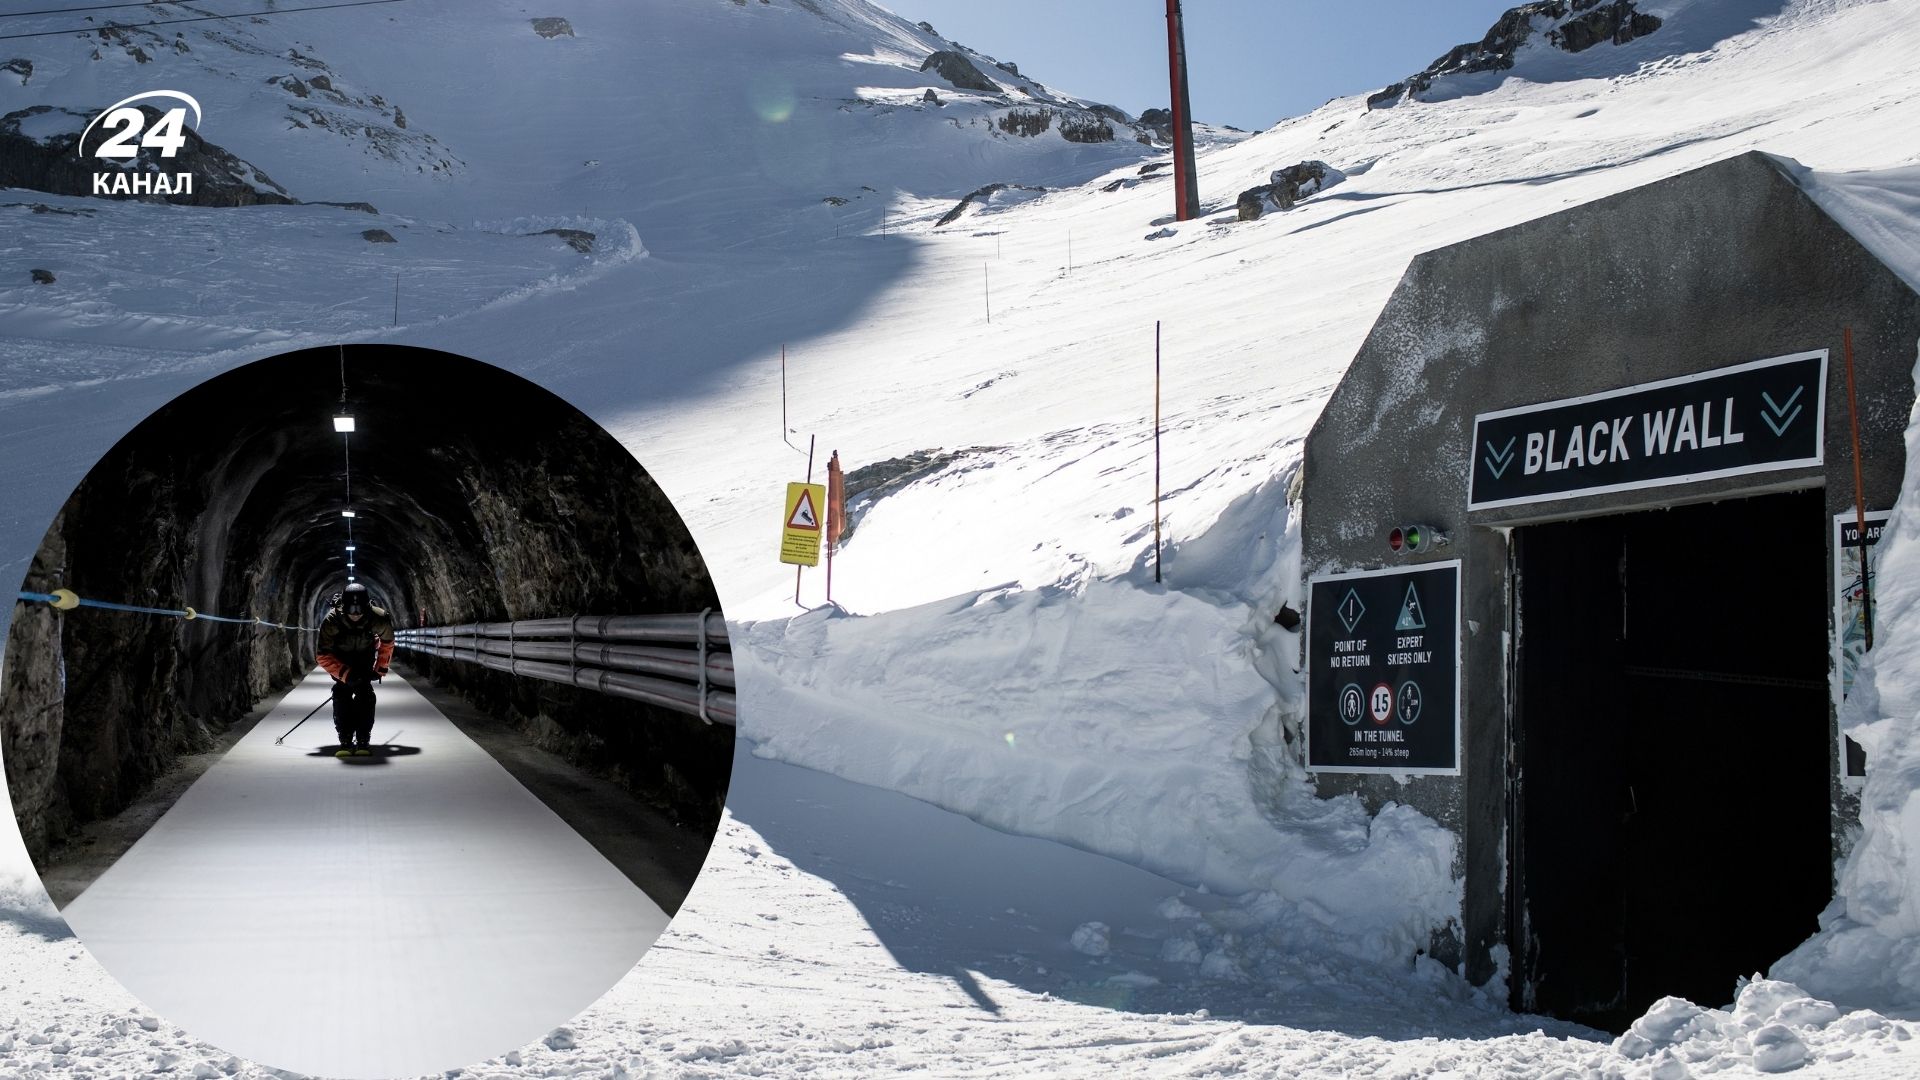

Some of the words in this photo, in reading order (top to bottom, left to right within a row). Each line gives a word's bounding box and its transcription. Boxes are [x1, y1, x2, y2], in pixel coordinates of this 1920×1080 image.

[1524, 415, 1634, 475] BLACK
[1643, 397, 1744, 458] WALL
[1845, 529, 1860, 541] YO
[1334, 640, 1356, 653] POINT
[1357, 639, 1367, 652] OF
[1397, 635, 1424, 649] EXPERT
[1331, 656, 1340, 668] NO
[1342, 655, 1370, 668] RETURN
[1387, 653, 1412, 665] SKIERS
[1413, 651, 1432, 664] ONLY
[1374, 694, 1389, 713] 15
[1354, 730, 1362, 742] IN
[1364, 730, 1378, 742] THE
[1378, 730, 1404, 742] TUNNEL
[1365, 747, 1377, 759] long
[1394, 747, 1409, 759] steep
